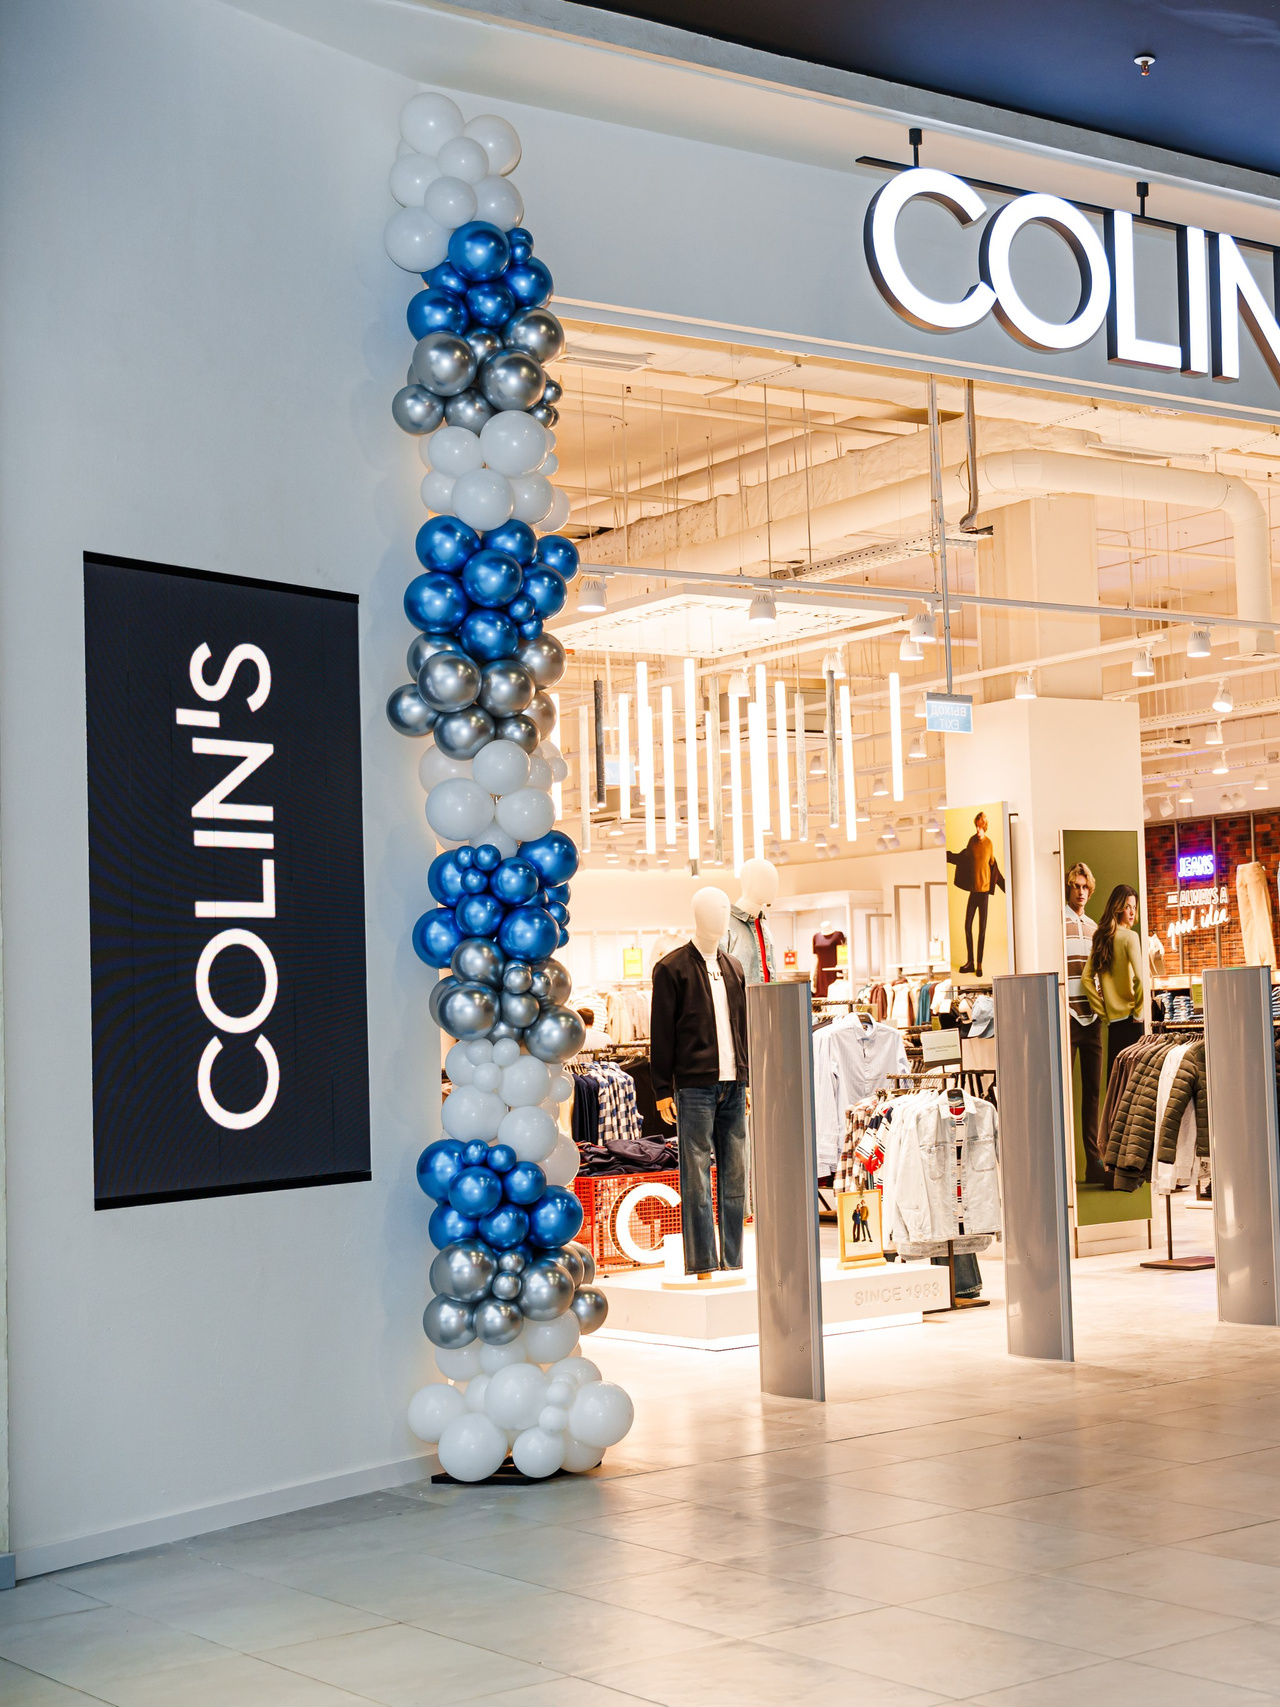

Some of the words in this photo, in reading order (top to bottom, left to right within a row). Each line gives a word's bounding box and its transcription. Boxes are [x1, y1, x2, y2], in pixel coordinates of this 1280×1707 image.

[1177, 854, 1214, 878] JEANS
[175, 641, 280, 1131] COLIN'S
[1219, 886, 1229, 904] A
[1167, 908, 1198, 952] good
[1200, 904, 1230, 929] idea
[854, 1286, 902, 1306] SINCE
[905, 1281, 941, 1299] 1983
